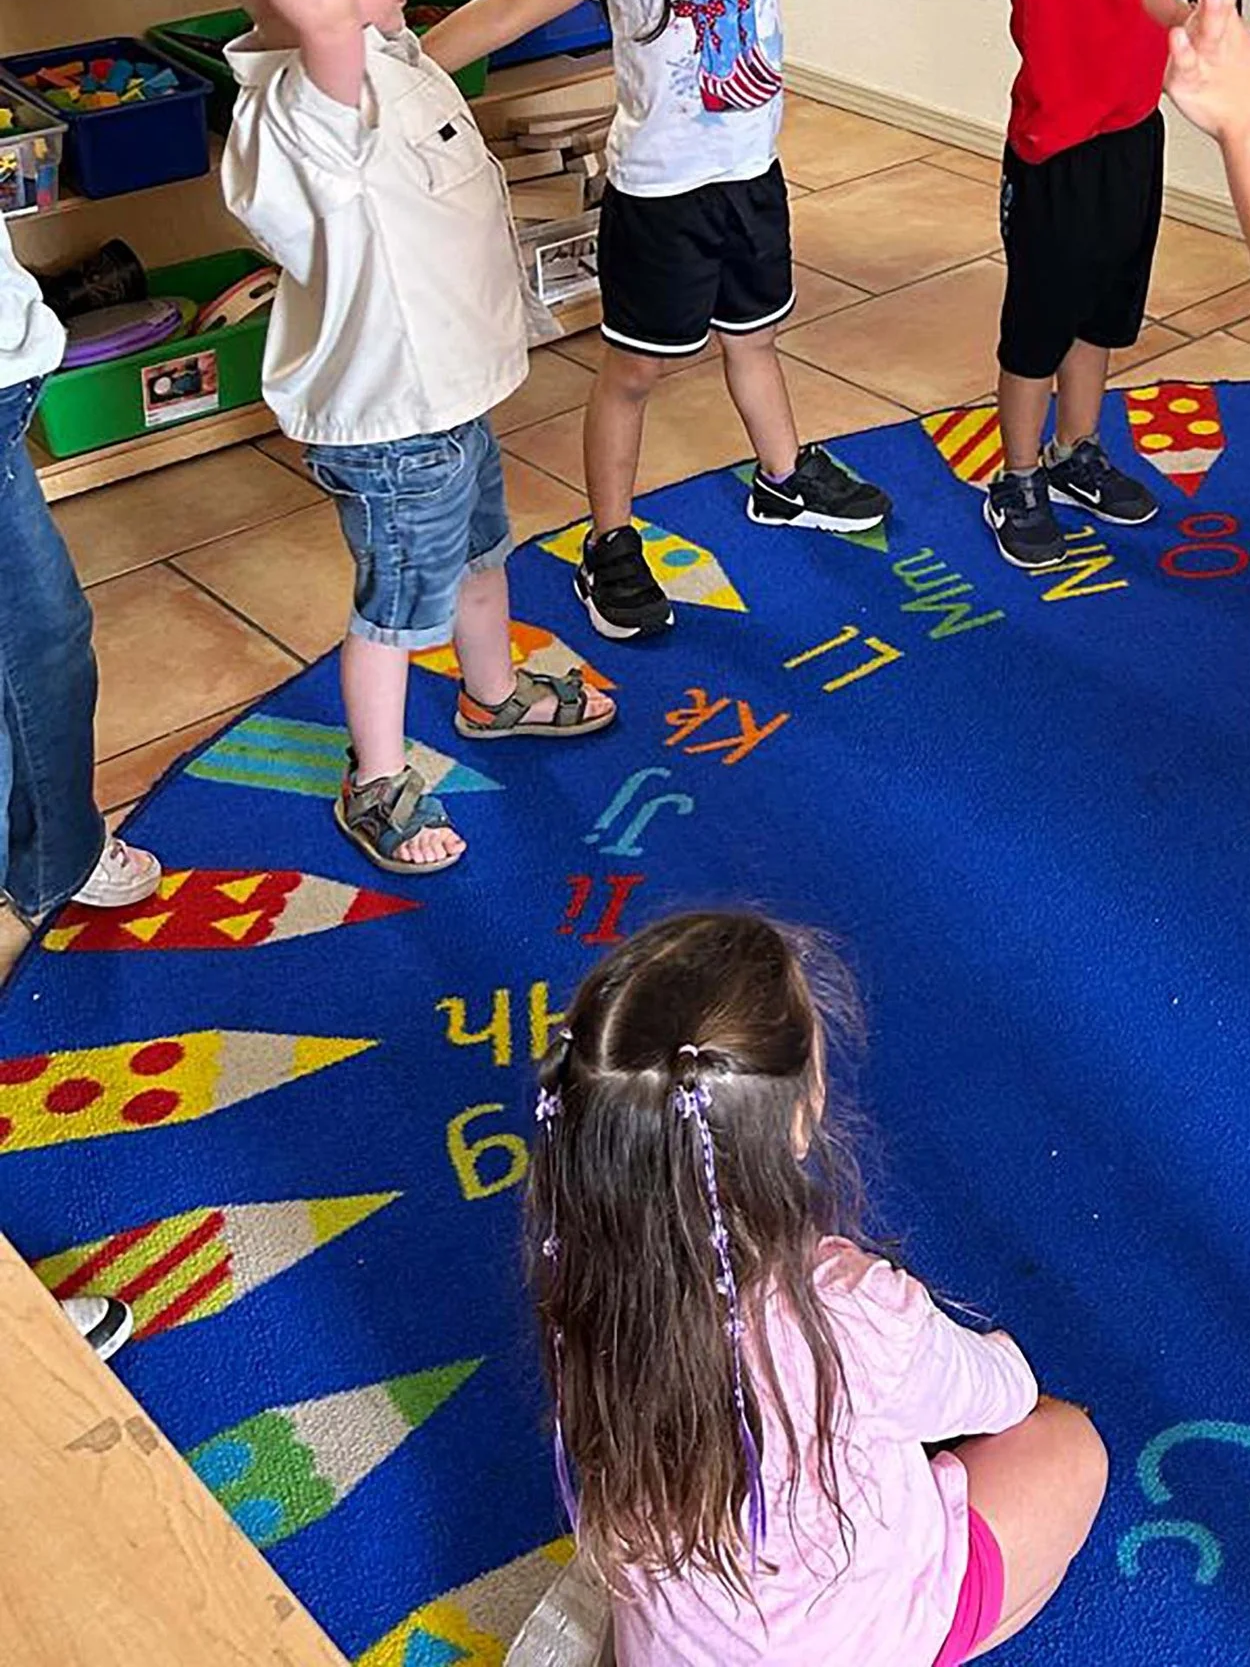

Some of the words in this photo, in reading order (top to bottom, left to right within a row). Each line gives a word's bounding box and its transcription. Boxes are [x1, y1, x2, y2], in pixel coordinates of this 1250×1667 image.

[891, 546, 1005, 640] Mm
[782, 625, 905, 693] Ll
[664, 686, 790, 764] Kk
[582, 766, 694, 857] Jj
[555, 874, 645, 945] Ii
[446, 1102, 529, 1202] g
